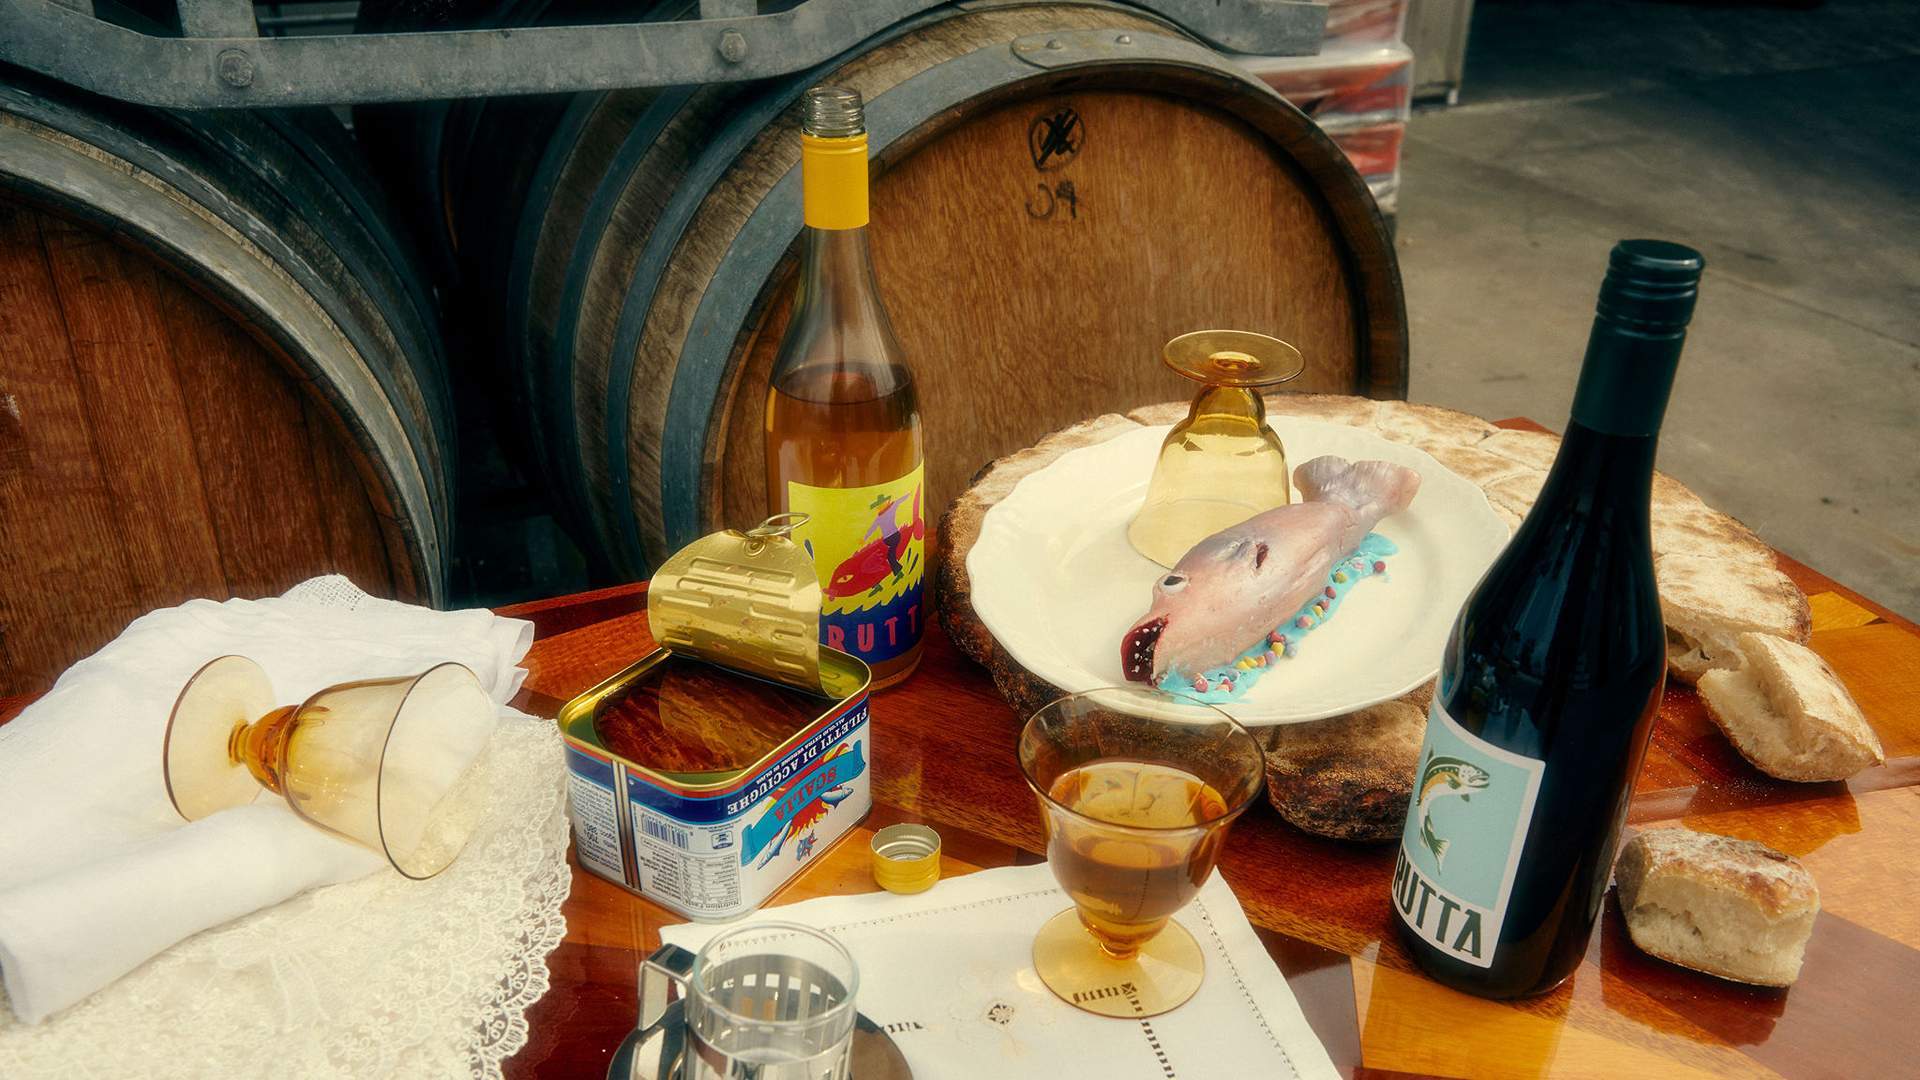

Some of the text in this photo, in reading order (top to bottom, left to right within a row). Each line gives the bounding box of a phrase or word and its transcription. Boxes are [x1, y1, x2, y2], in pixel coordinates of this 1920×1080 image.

[828, 592, 925, 652] RUTT
[727, 706, 867, 815] FILETTI DI ACCIUGHE
[774, 766, 837, 820] SCALIA
[1394, 845, 1481, 959] RUTTA
